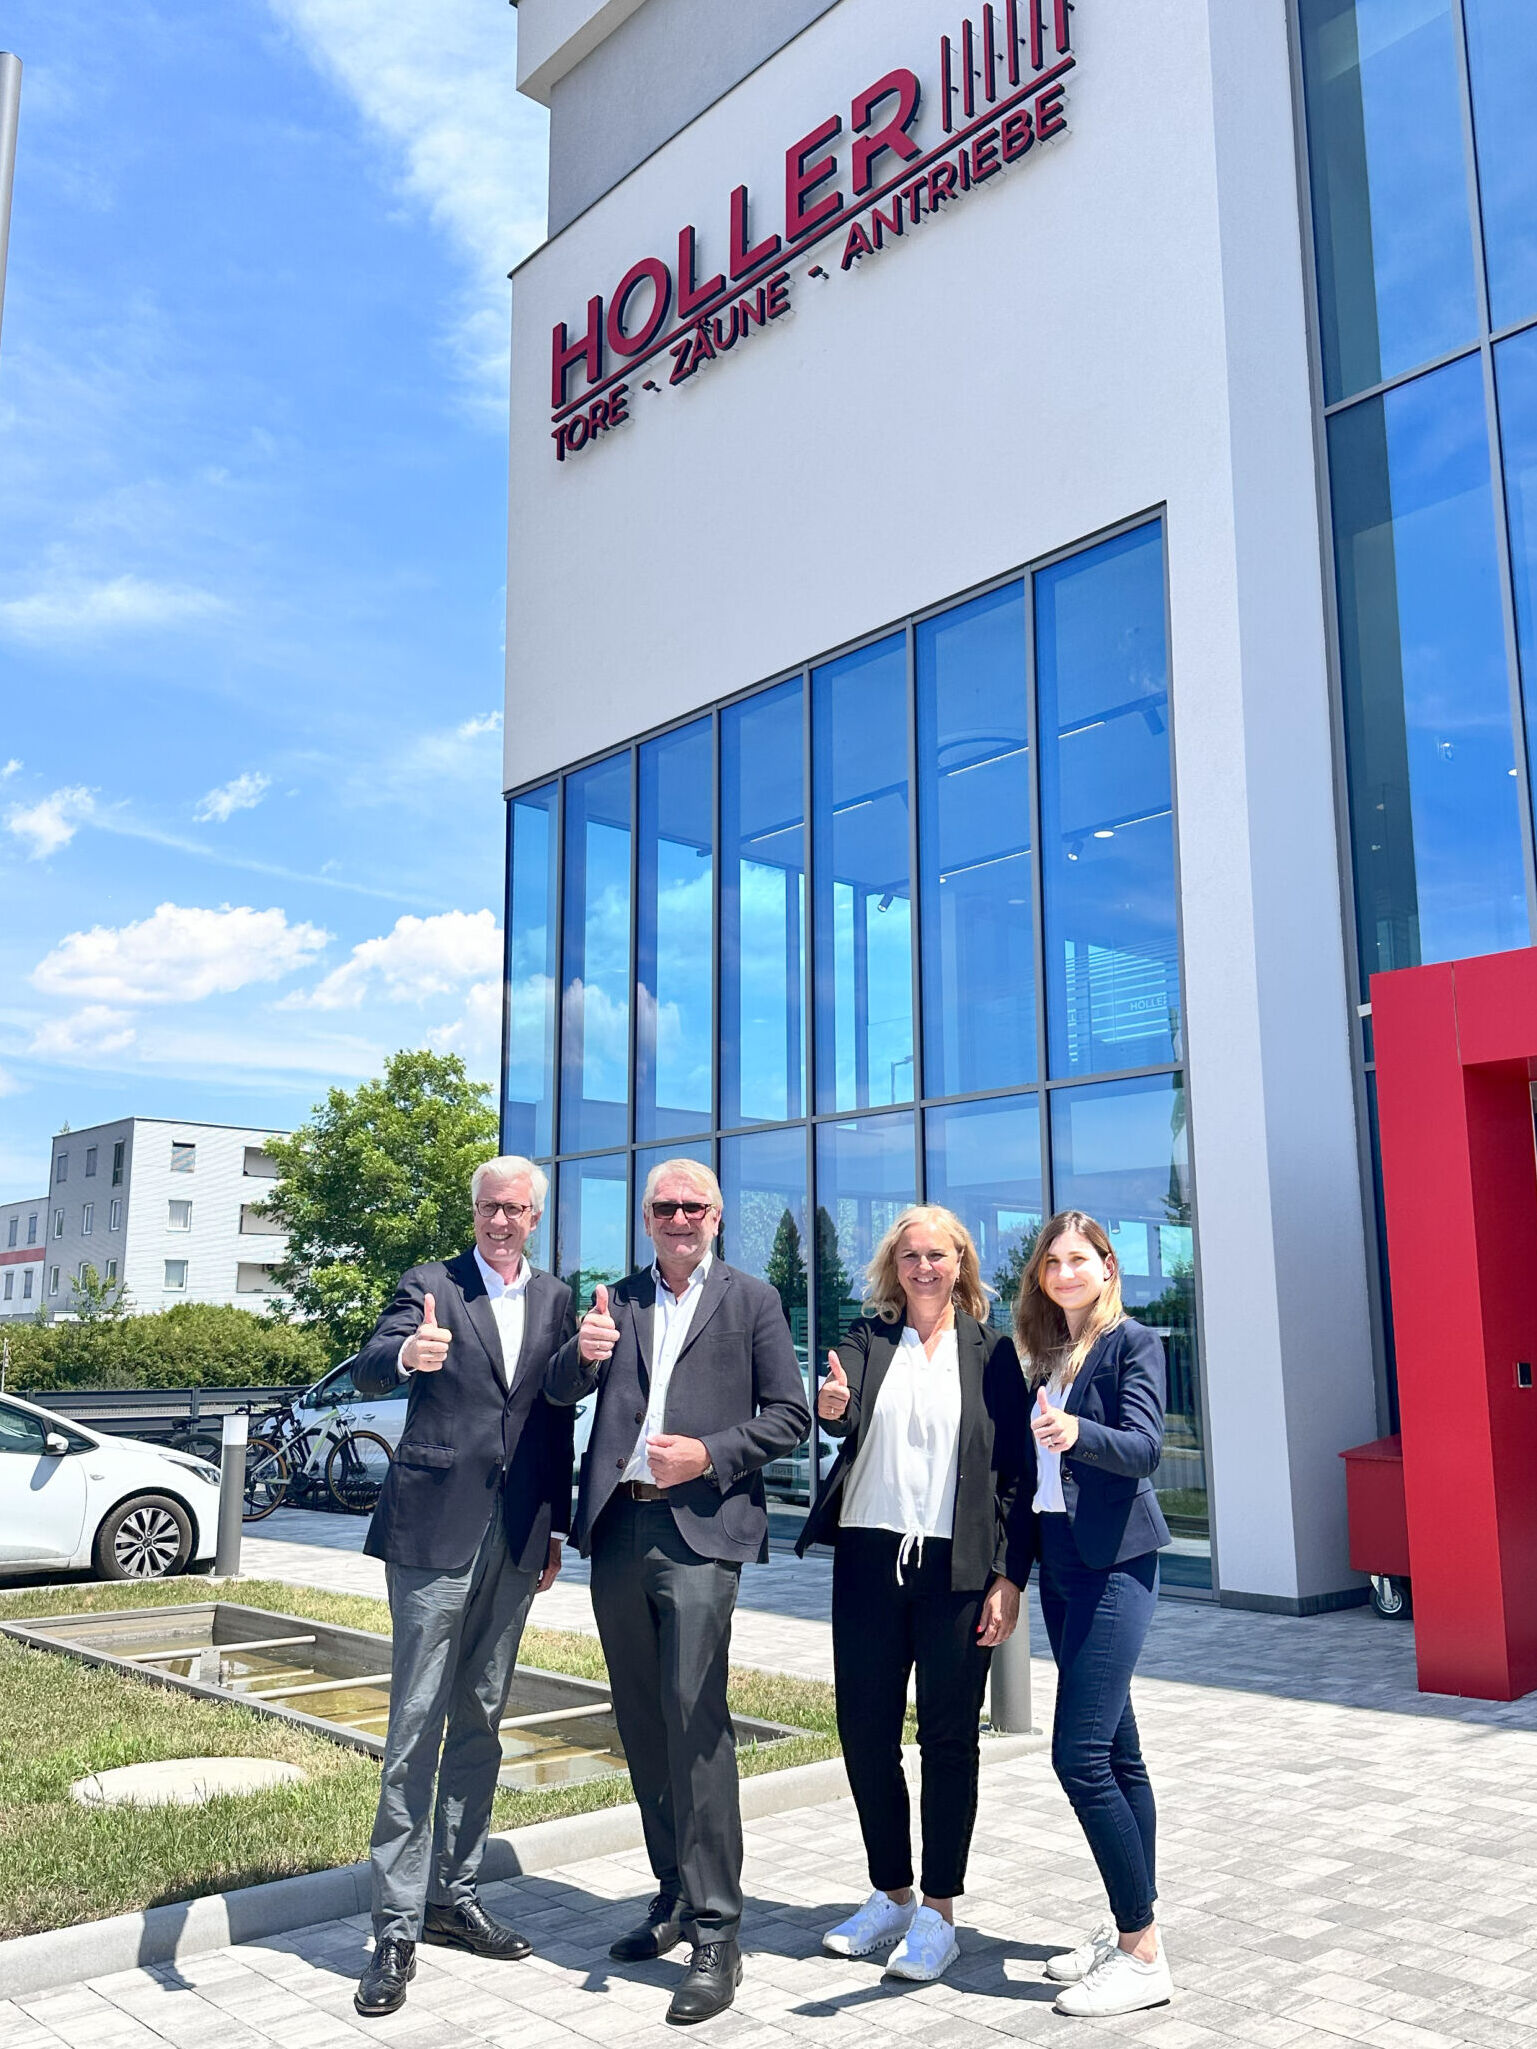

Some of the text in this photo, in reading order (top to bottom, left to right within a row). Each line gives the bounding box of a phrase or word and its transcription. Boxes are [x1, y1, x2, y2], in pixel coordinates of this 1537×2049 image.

[551, 383, 630, 462] TORE
[669, 271, 791, 386] ZÄUNE
[841, 83, 1068, 271] ANTRIEBE
[552, 68, 923, 410] HOLLER
